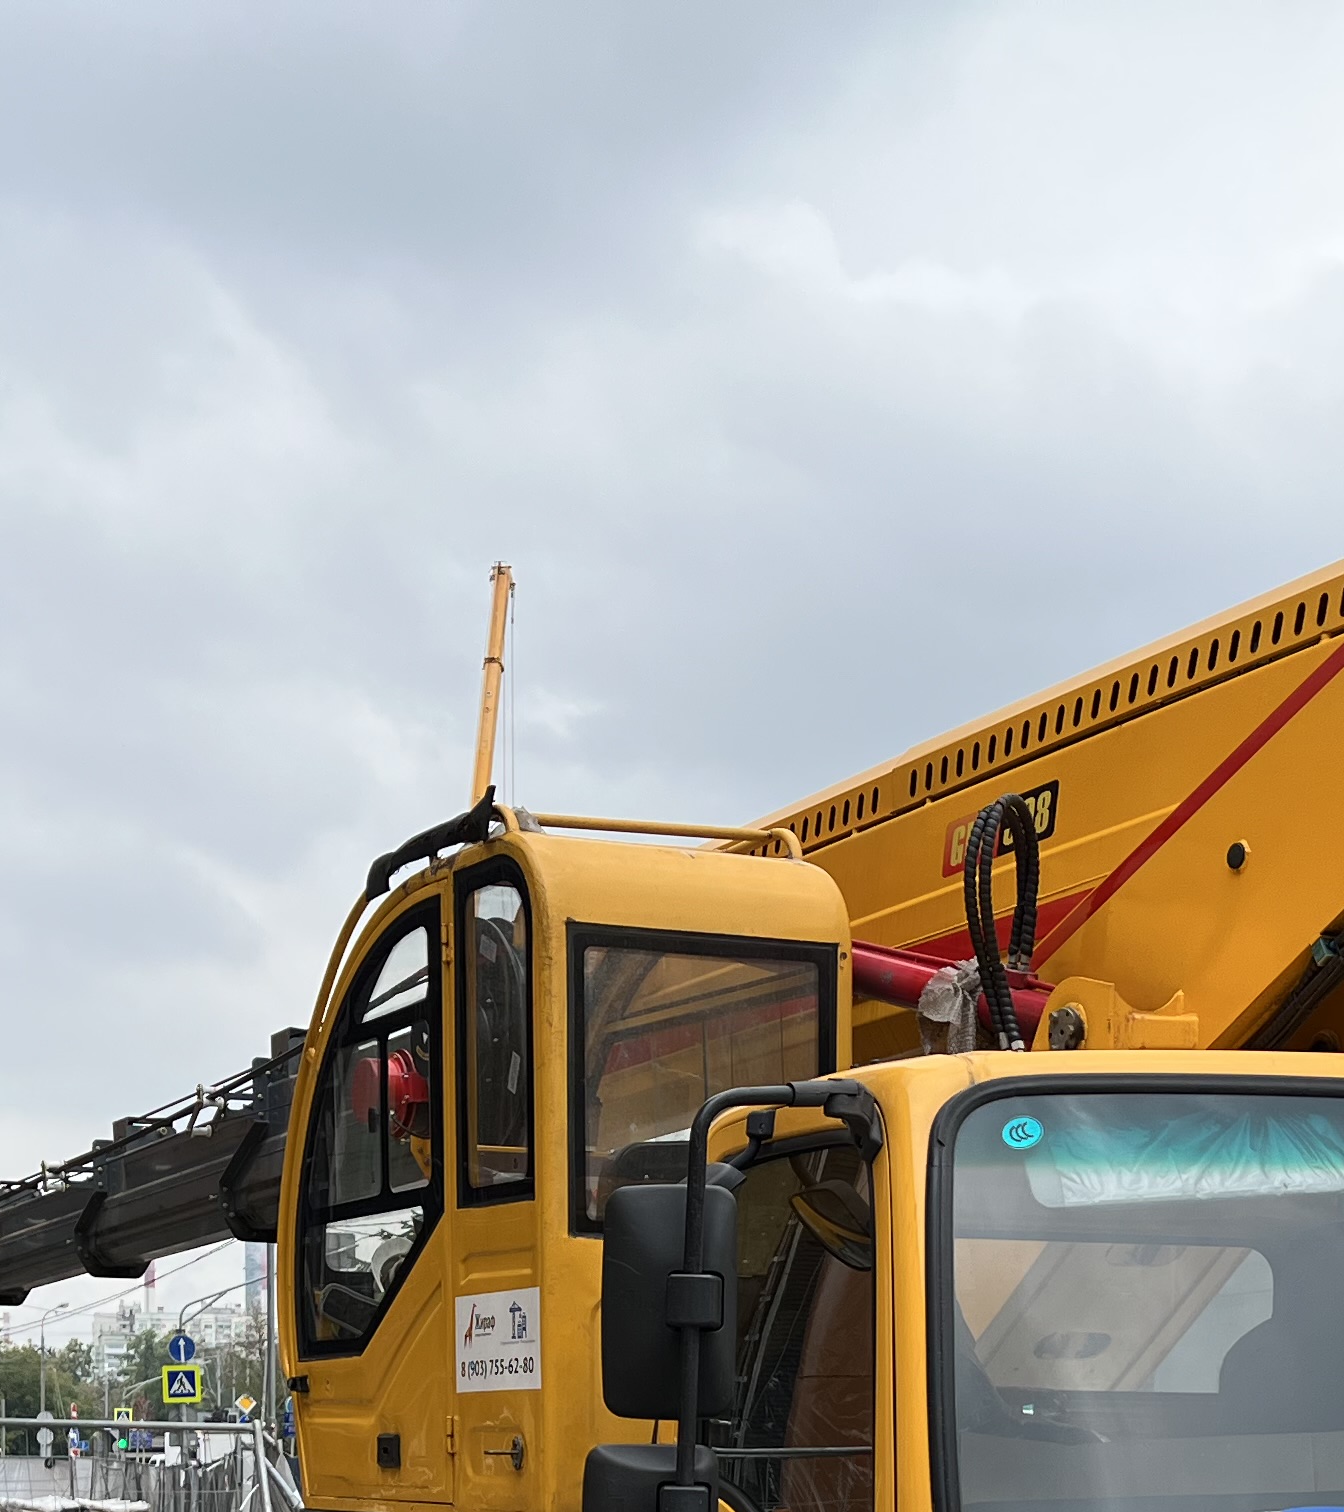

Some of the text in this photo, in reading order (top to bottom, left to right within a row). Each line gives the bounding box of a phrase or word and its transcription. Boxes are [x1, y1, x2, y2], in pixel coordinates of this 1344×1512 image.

[474, 1312, 496, 1332] Жираф
[460, 1356, 535, 1381] 8 (903) 755-62-80
